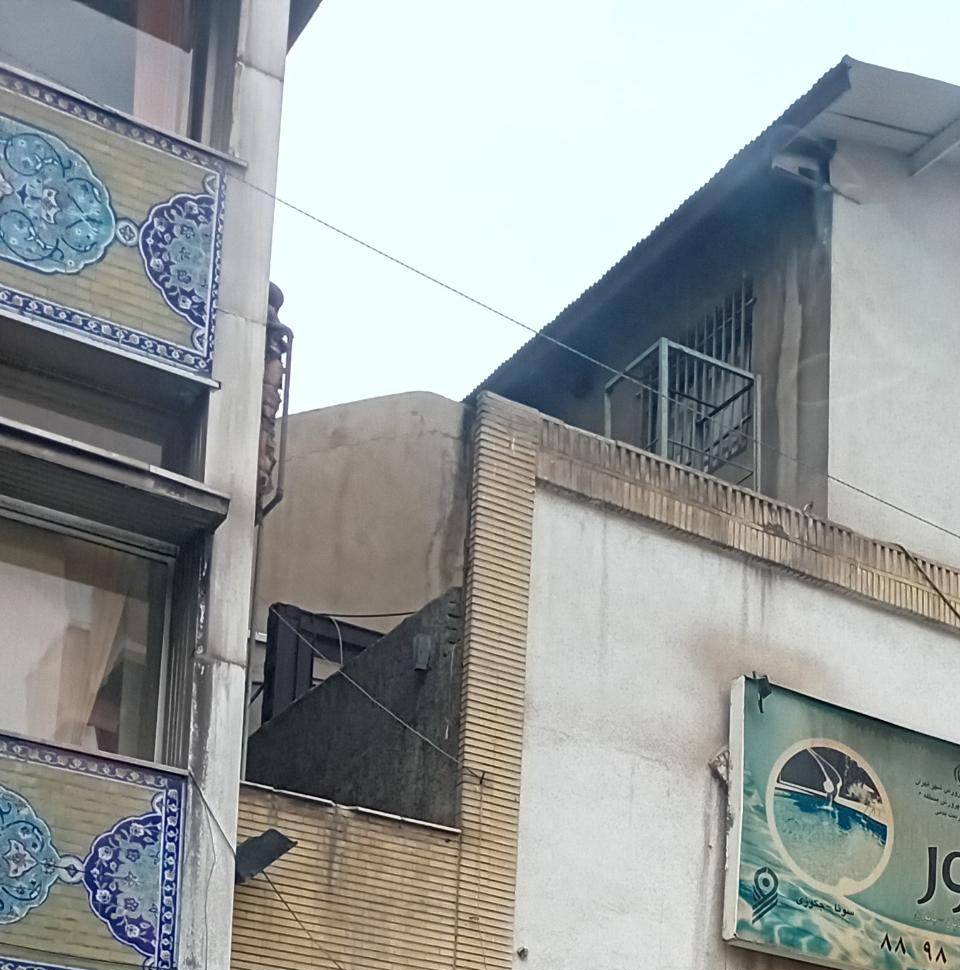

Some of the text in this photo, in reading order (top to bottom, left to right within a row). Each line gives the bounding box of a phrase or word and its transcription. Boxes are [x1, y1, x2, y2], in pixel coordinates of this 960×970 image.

[834, 903, 855, 917] سونا
[880, 933, 907, 955] ۸۸
[923, 940, 948, 964] ۹۸
